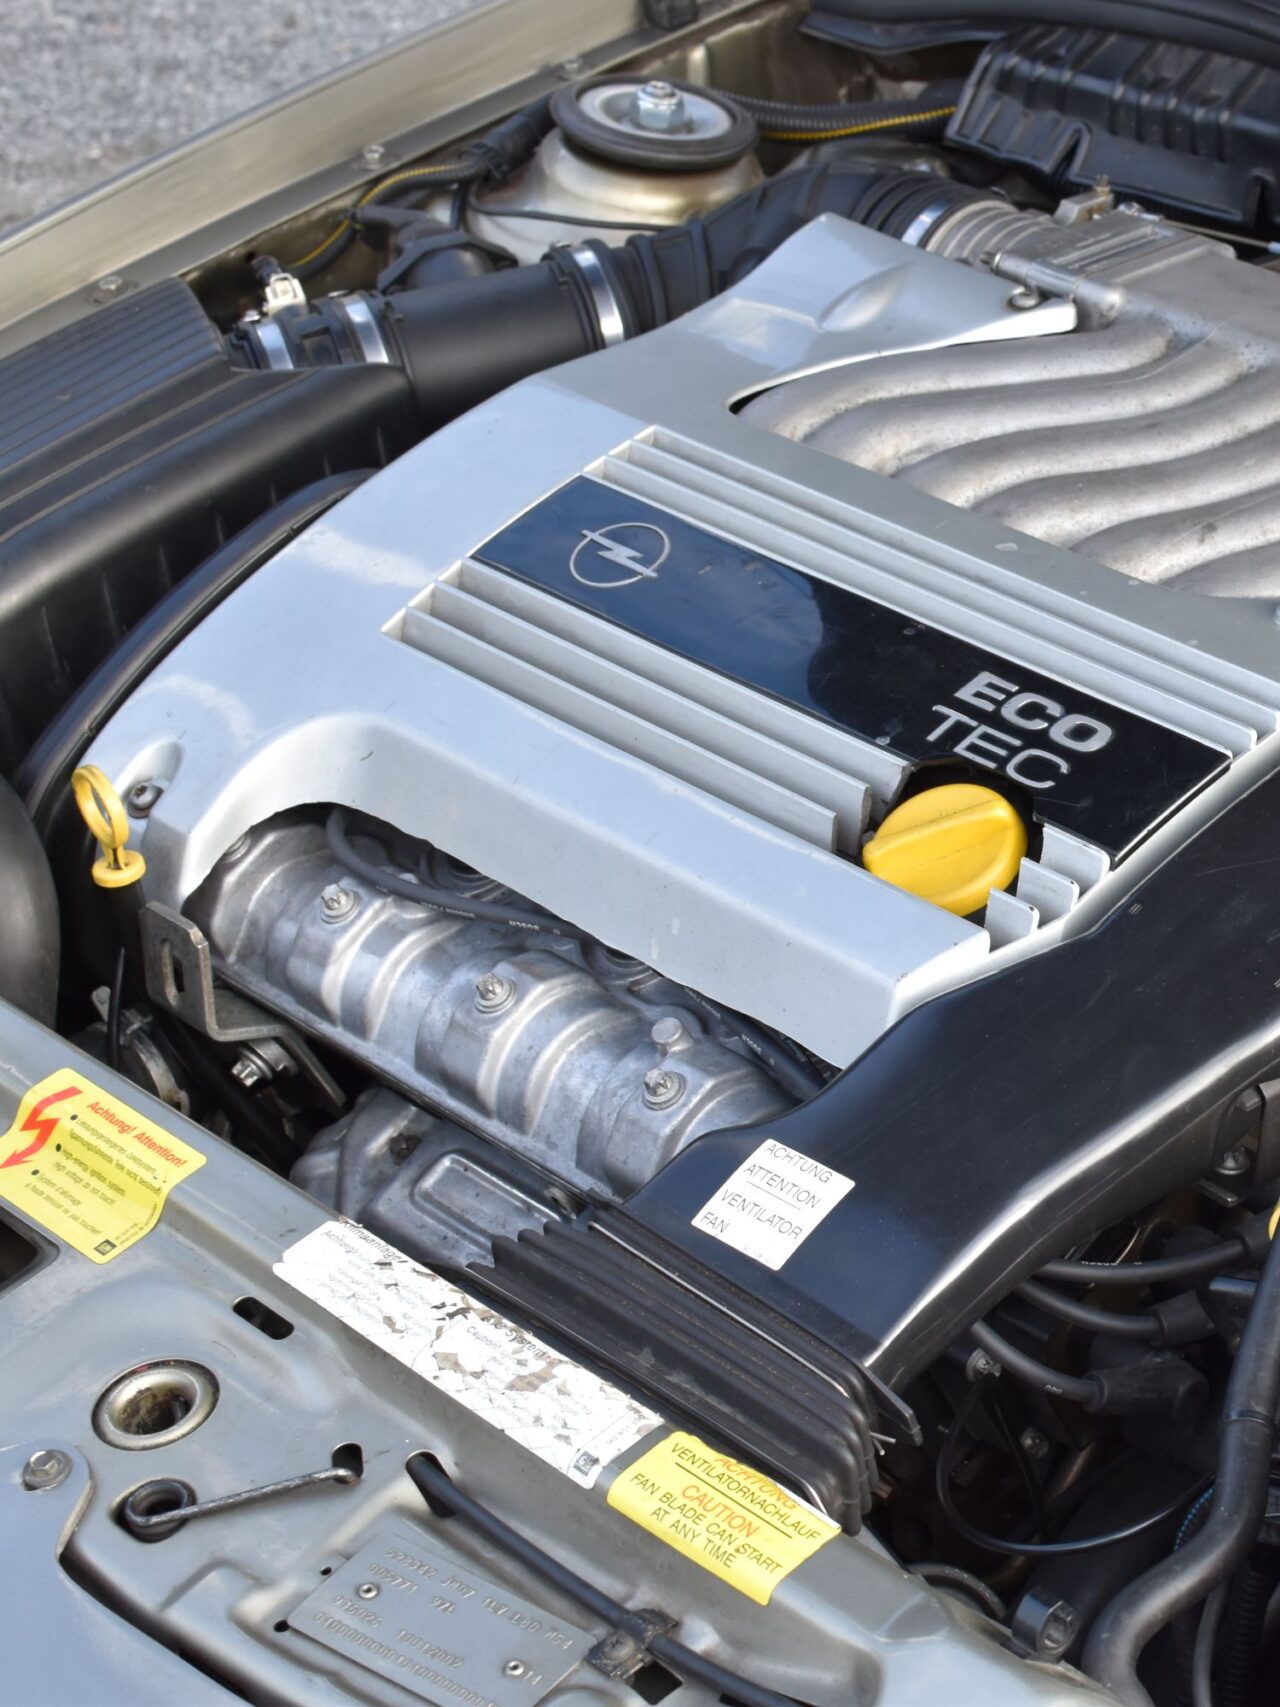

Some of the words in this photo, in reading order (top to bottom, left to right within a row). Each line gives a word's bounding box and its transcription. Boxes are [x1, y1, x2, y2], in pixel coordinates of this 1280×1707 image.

[953, 671, 1114, 752] ECO
[926, 704, 1070, 789] TEC
[87, 1101, 137, 1135] Achtung!
[133, 1132, 188, 1168] Attention!
[743, 1163, 821, 1209] ATTENTION
[763, 1143, 833, 1184] ACHTUNG
[700, 1211, 731, 1233] FAN
[721, 1189, 803, 1240] VENTILATOR
[505, 1326, 549, 1359] System
[671, 1442, 821, 1542] VENTILATORNACHLAUF
[681, 1484, 760, 1538] CAUTION
[713, 1456, 799, 1511] ACHTUNG
[630, 1472, 661, 1497] FAN
[659, 1490, 707, 1526] BLADE
[705, 1521, 738, 1547] CAN
[736, 1542, 783, 1575] START
[650, 1506, 670, 1523] AT
[669, 1520, 700, 1544] ANY
[701, 1537, 738, 1570] TIME
